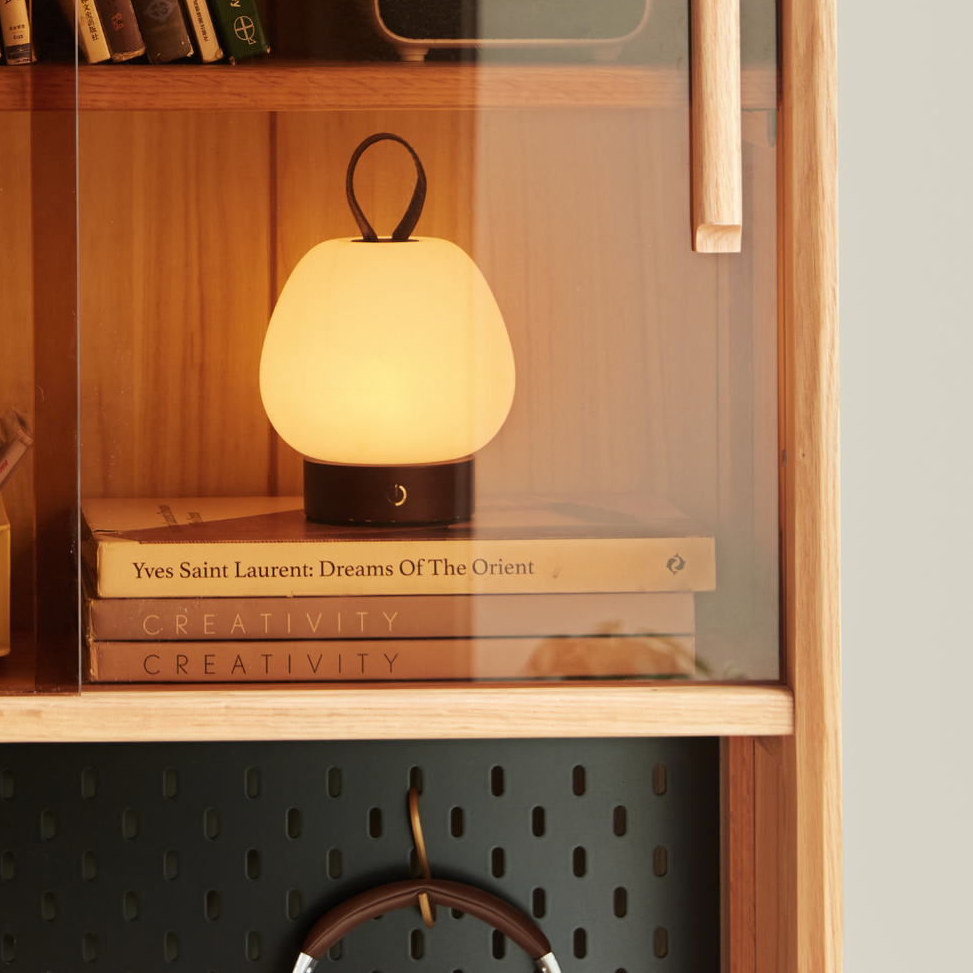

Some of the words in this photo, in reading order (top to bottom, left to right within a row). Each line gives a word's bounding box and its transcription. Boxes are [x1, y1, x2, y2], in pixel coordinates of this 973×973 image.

[132, 562, 174, 579] Yves
[180, 561, 229, 579] Saint
[234, 561, 314, 578] Laurent:
[319, 560, 394, 577] Dreams
[399, 558, 426, 577] Of
[428, 558, 467, 576] The
[472, 558, 535, 576] Orient
[142, 611, 398, 636] CREATIVITY
[143, 653, 399, 675] CREATIVITY
